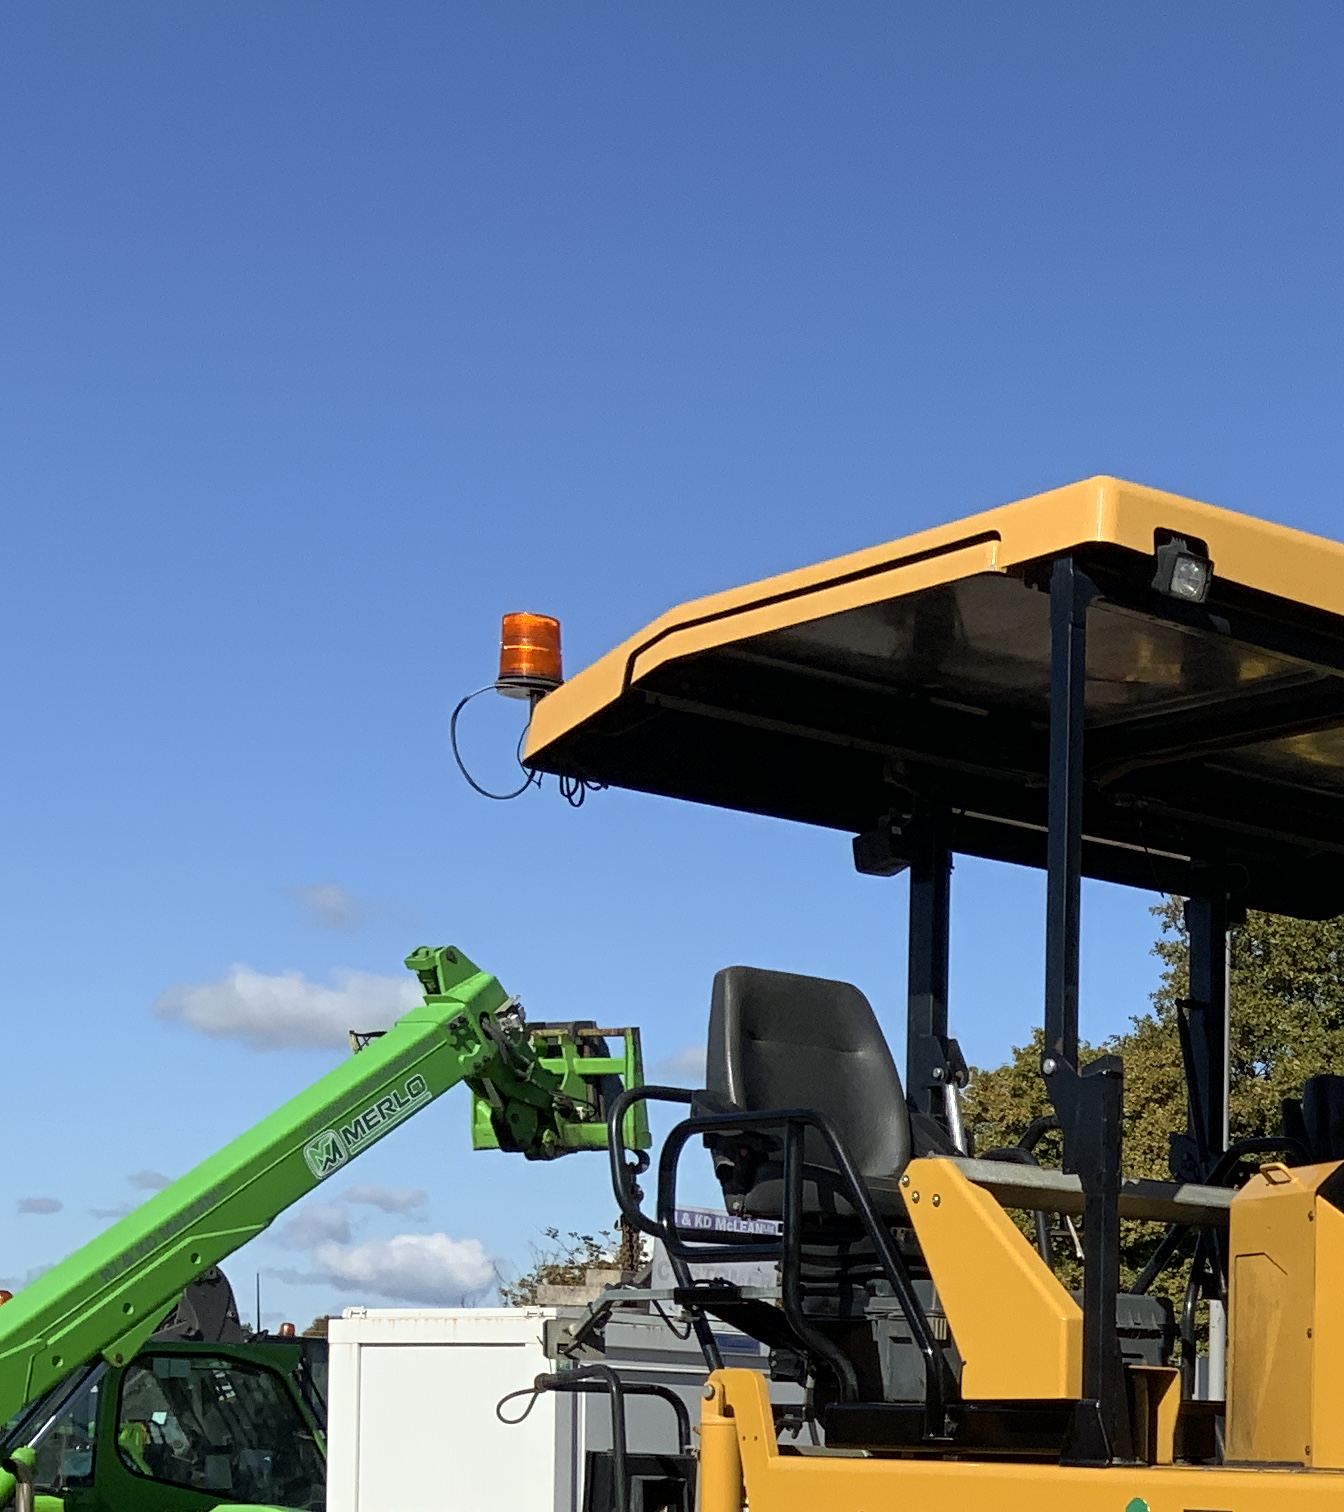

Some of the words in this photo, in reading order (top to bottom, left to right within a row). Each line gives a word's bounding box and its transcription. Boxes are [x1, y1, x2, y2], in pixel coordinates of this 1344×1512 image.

[340, 1074, 427, 1148] MERLO
[682, 1211, 691, 1226] &
[694, 1214, 712, 1229] KD
[715, 1218, 763, 1233] McLEAN
